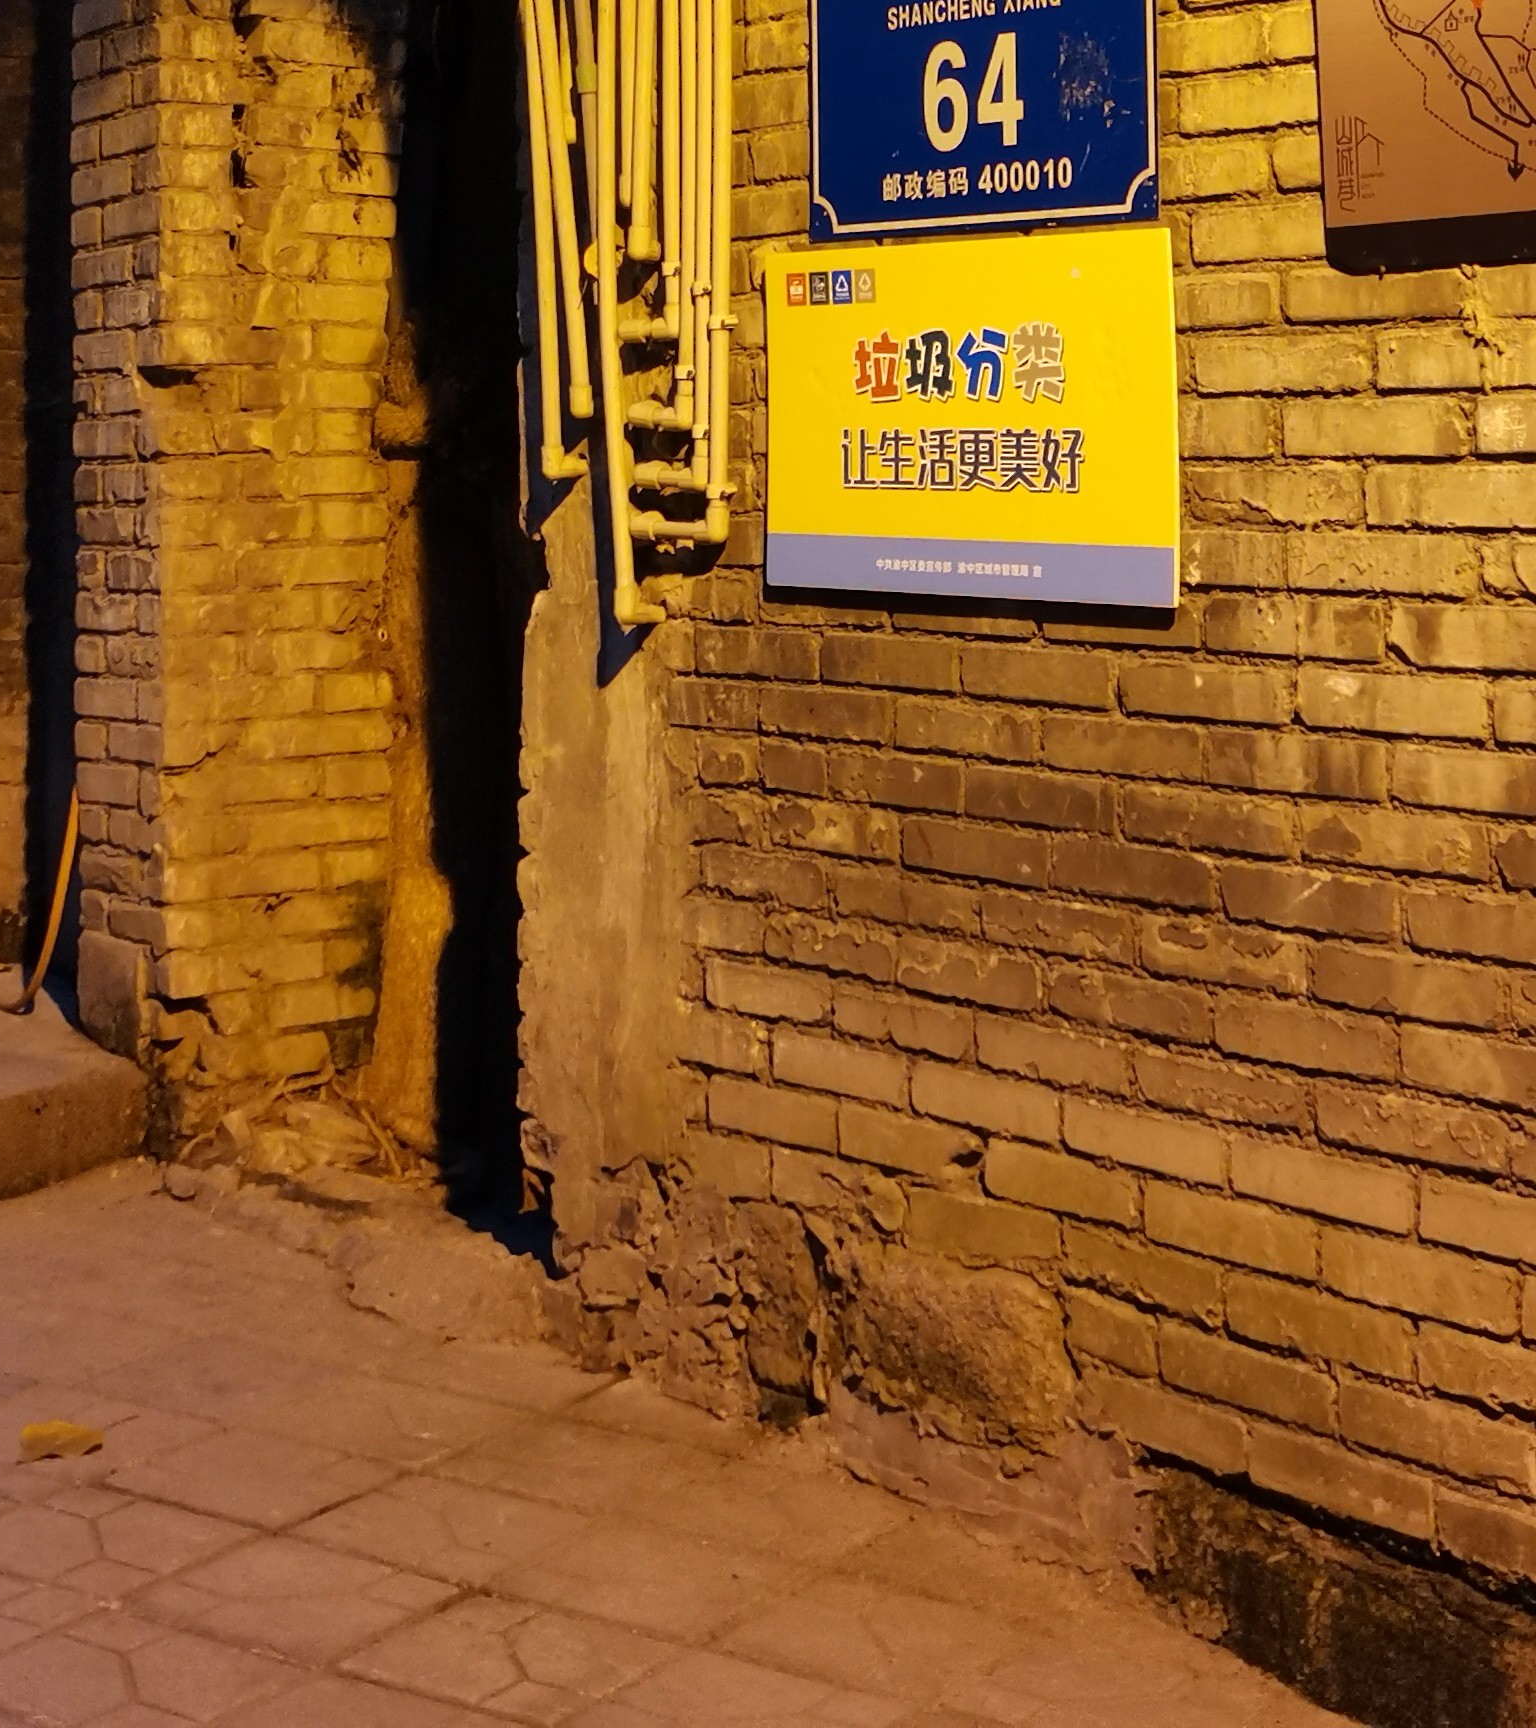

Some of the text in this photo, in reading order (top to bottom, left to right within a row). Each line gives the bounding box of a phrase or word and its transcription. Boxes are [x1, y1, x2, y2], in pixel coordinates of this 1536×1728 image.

[923, 32, 1024, 153] 64
[882, 156, 1073, 202] 邮政编码 400010
[852, 321, 1066, 403] 垃圾分类
[841, 426, 1085, 493] 让生活更美好
